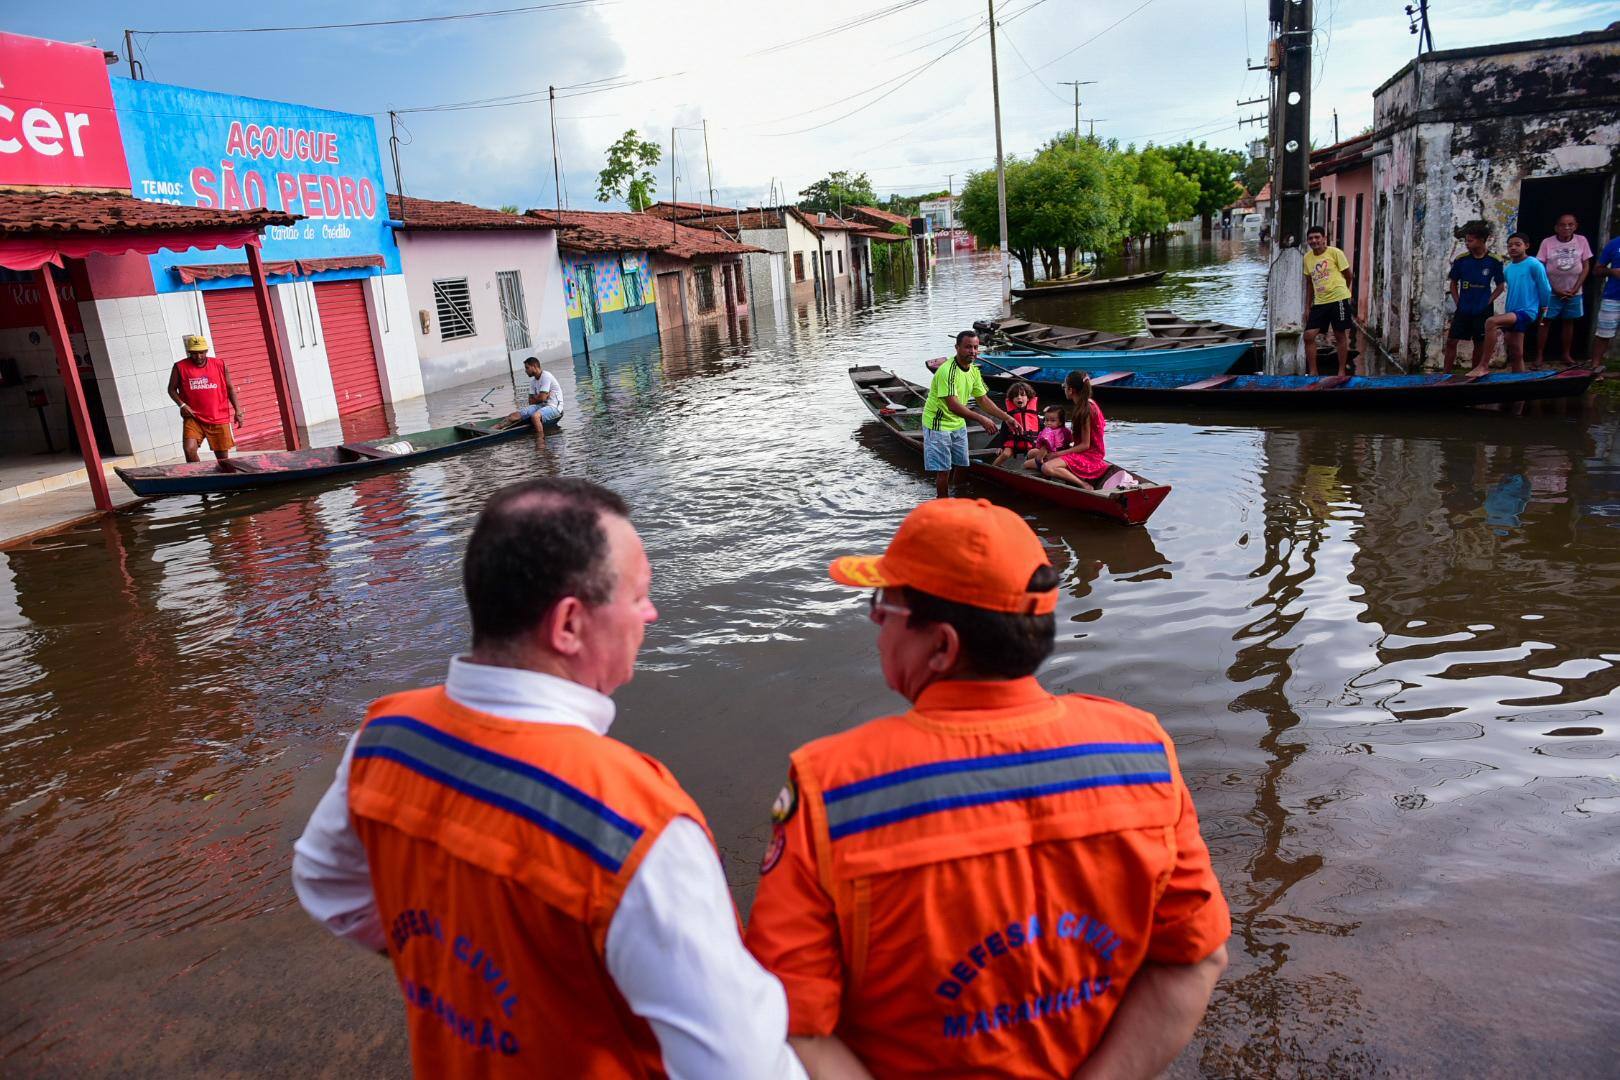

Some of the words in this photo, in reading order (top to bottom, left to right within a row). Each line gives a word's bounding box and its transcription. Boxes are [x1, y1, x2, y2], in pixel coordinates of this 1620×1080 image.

[226, 121, 340, 164] AÇOUGUE
[141, 180, 184, 195] TEMOS:
[189, 159, 267, 211] SÃO
[275, 171, 376, 220] PEDRO
[303, 224, 315, 240] de
[453, 935, 518, 1017] CIVIL
[936, 915, 1042, 1000] DEFESA
[1057, 911, 1121, 961] CIVIL
